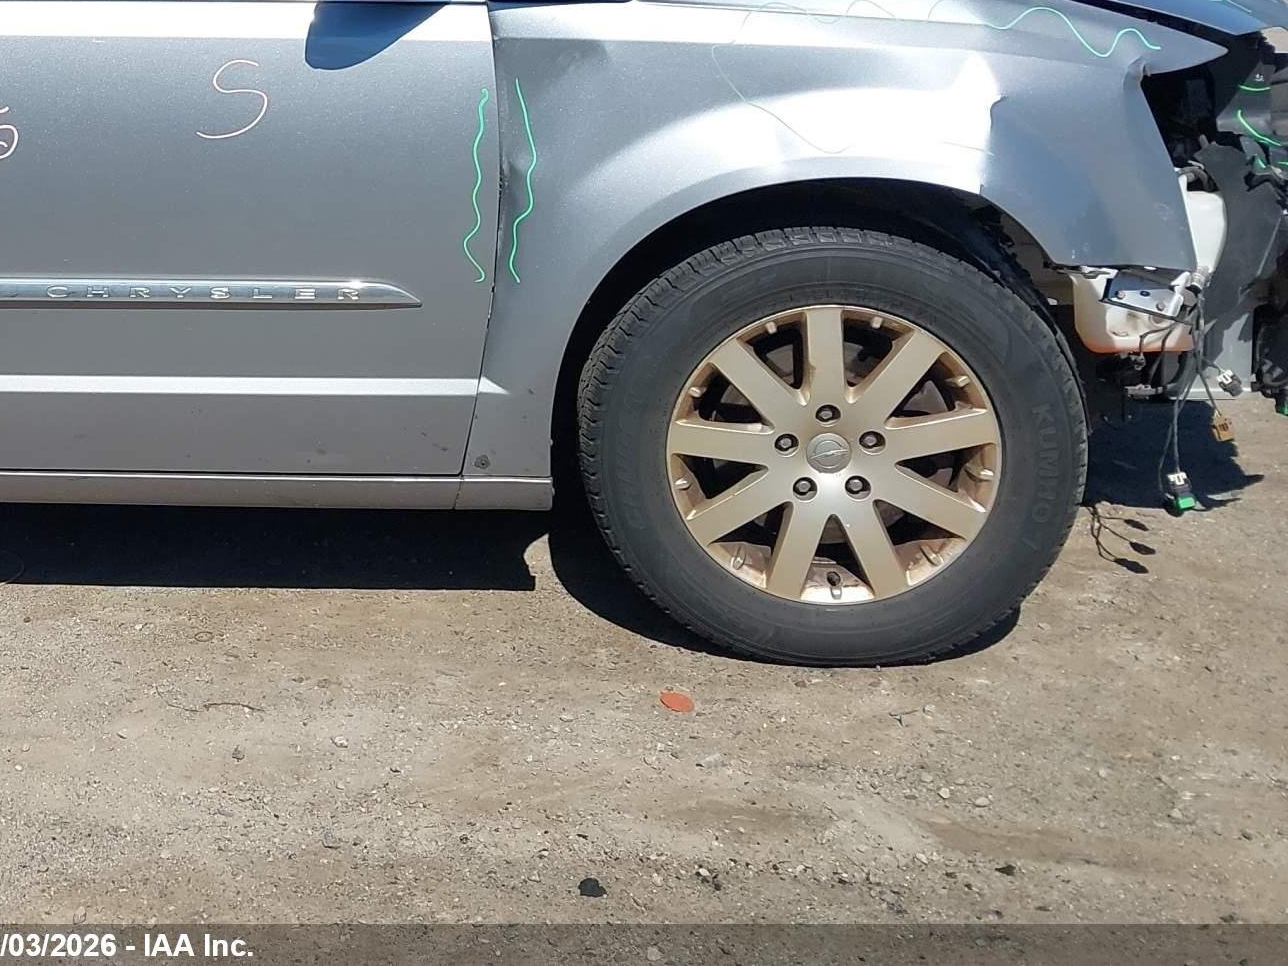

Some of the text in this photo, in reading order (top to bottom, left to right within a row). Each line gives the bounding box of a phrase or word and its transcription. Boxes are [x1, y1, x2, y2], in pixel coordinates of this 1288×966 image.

[195, 59, 268, 139] S
[45, 284, 361, 301] CHRYSLER
[1030, 401, 1060, 524] KUMHO
